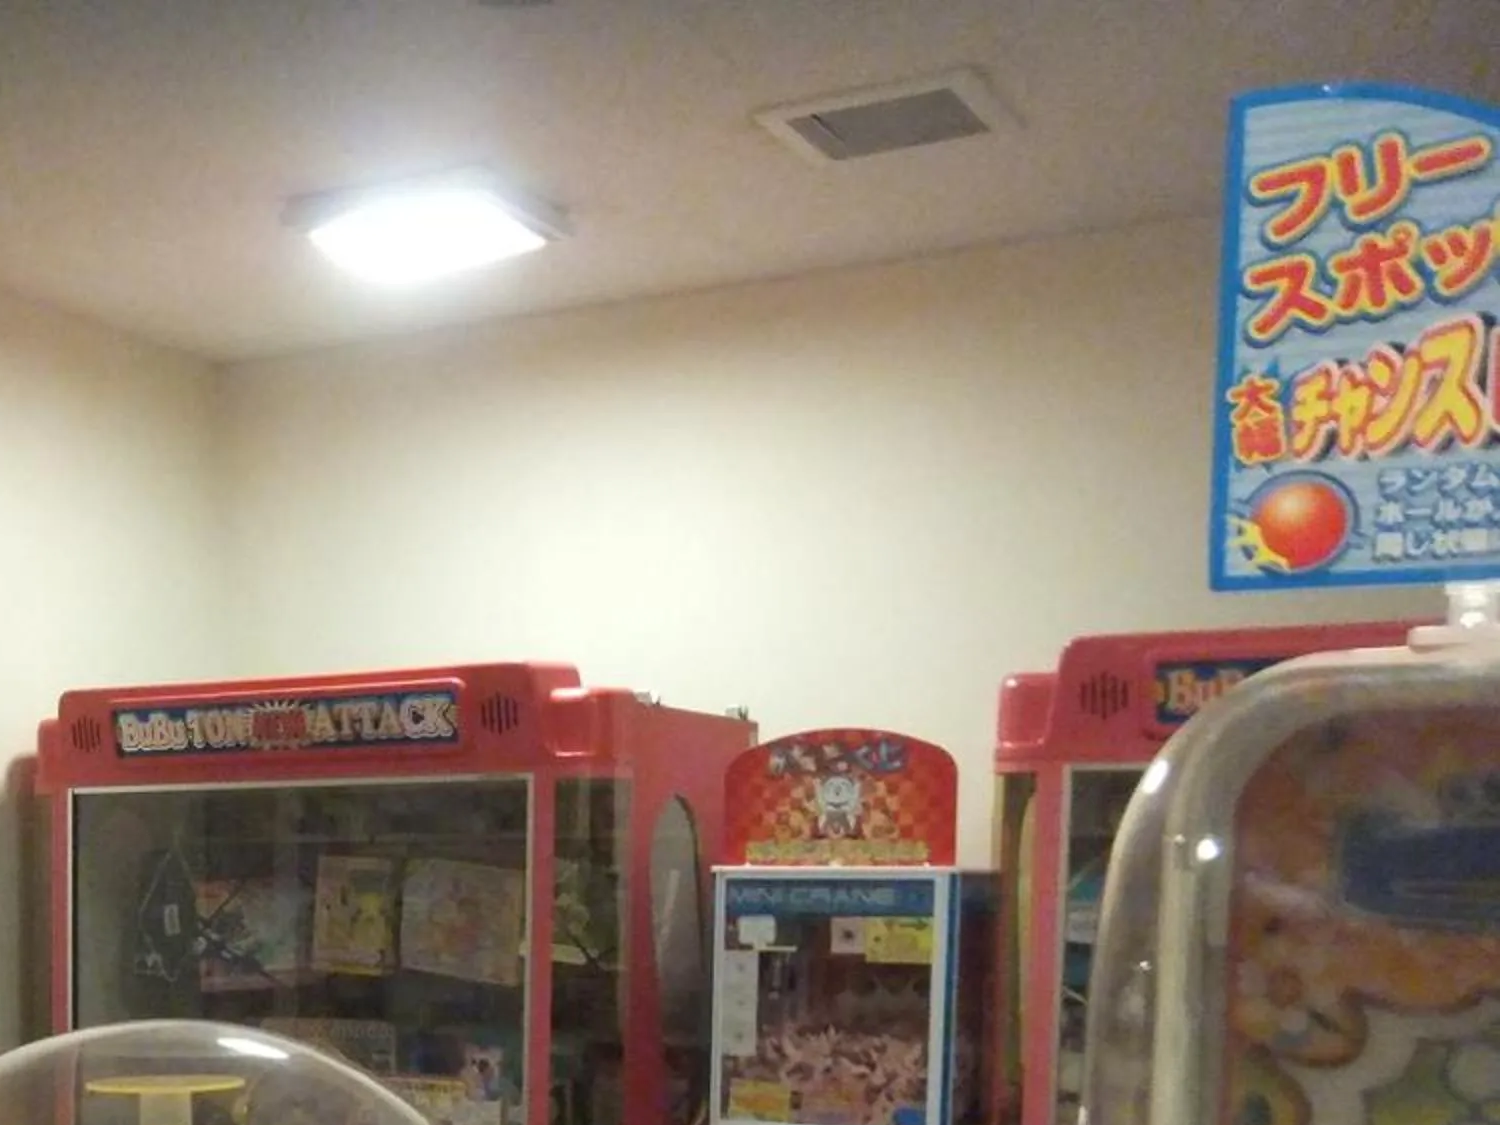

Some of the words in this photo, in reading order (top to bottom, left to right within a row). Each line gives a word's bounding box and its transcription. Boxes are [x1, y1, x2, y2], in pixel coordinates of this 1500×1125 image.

[1249, 133, 1490, 241] フリー
[1245, 222, 1500, 338] スポッ
[308, 695, 457, 743] ATTACK
